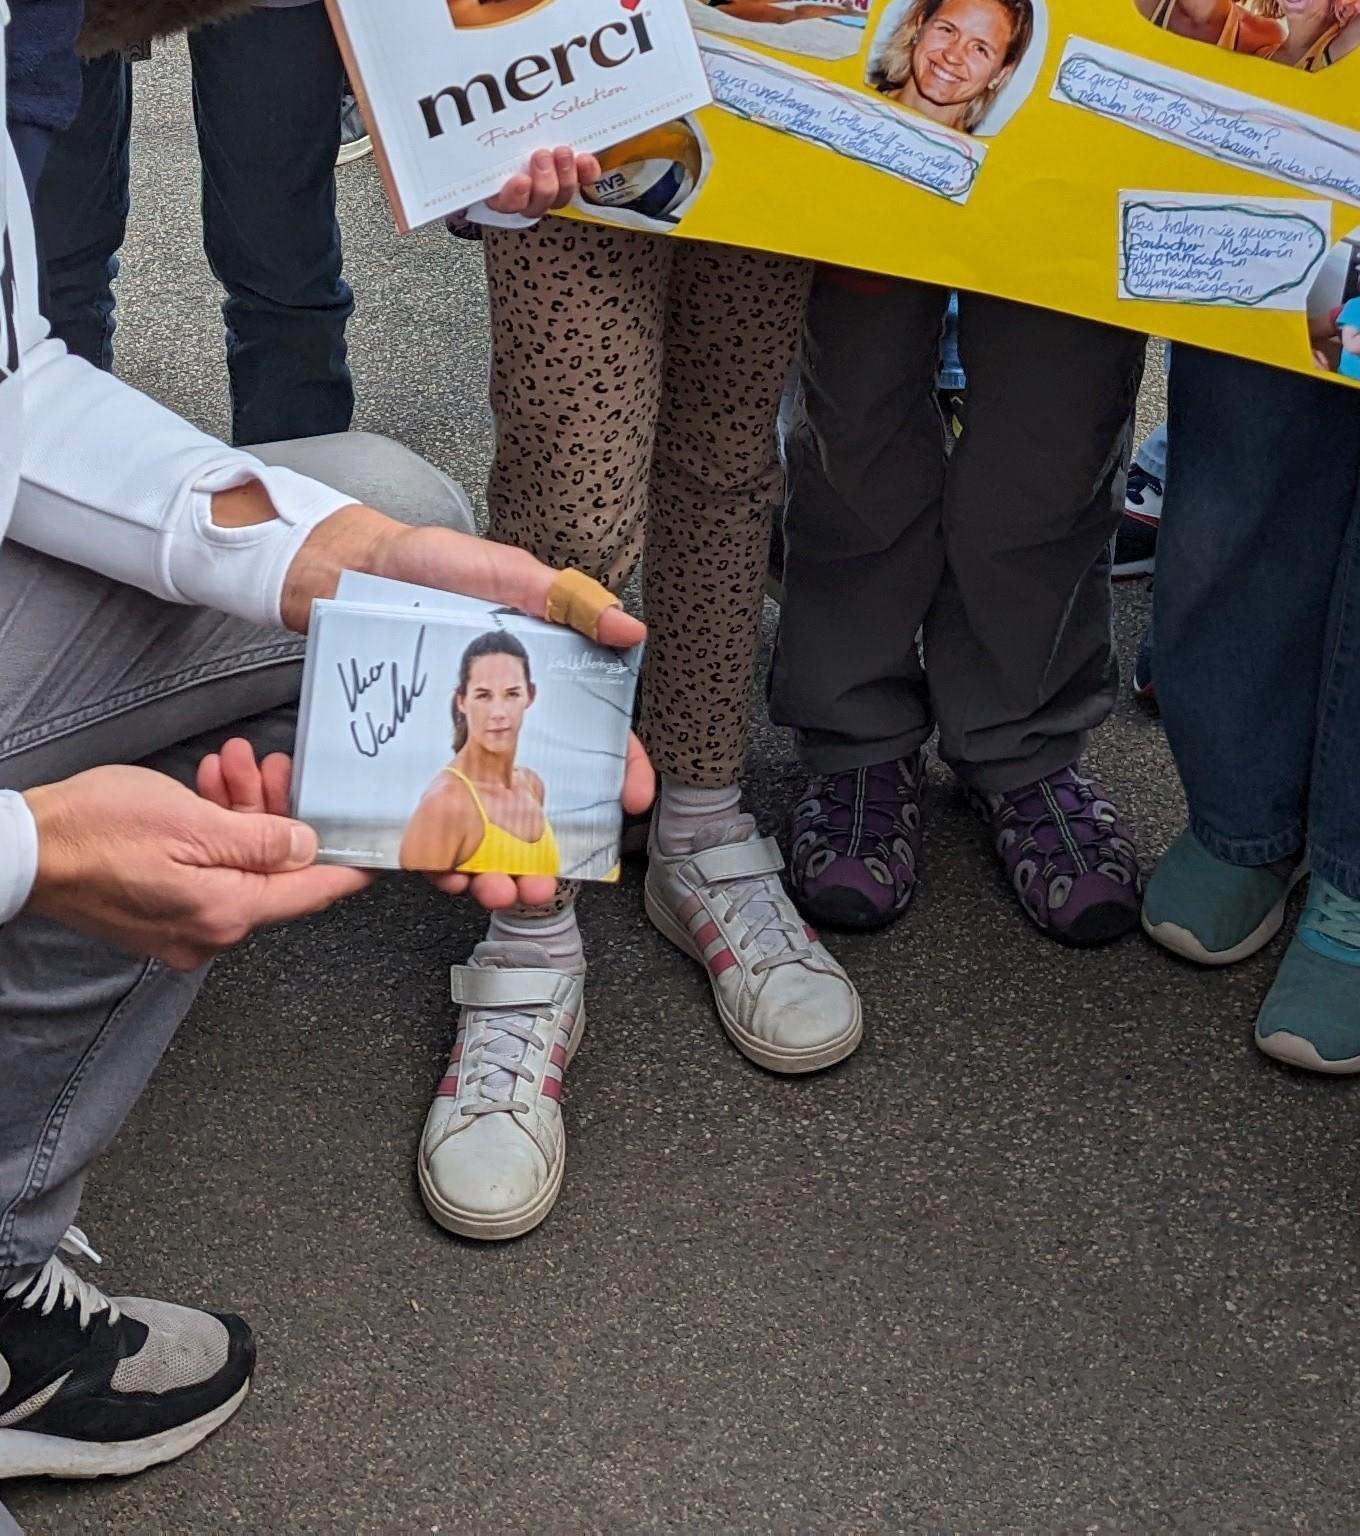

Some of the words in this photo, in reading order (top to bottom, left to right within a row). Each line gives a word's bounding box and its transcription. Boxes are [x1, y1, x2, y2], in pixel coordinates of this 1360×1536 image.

[417, 10, 654, 139] merci
[476, 110, 549, 148] Finest
[550, 83, 628, 121] Selection
